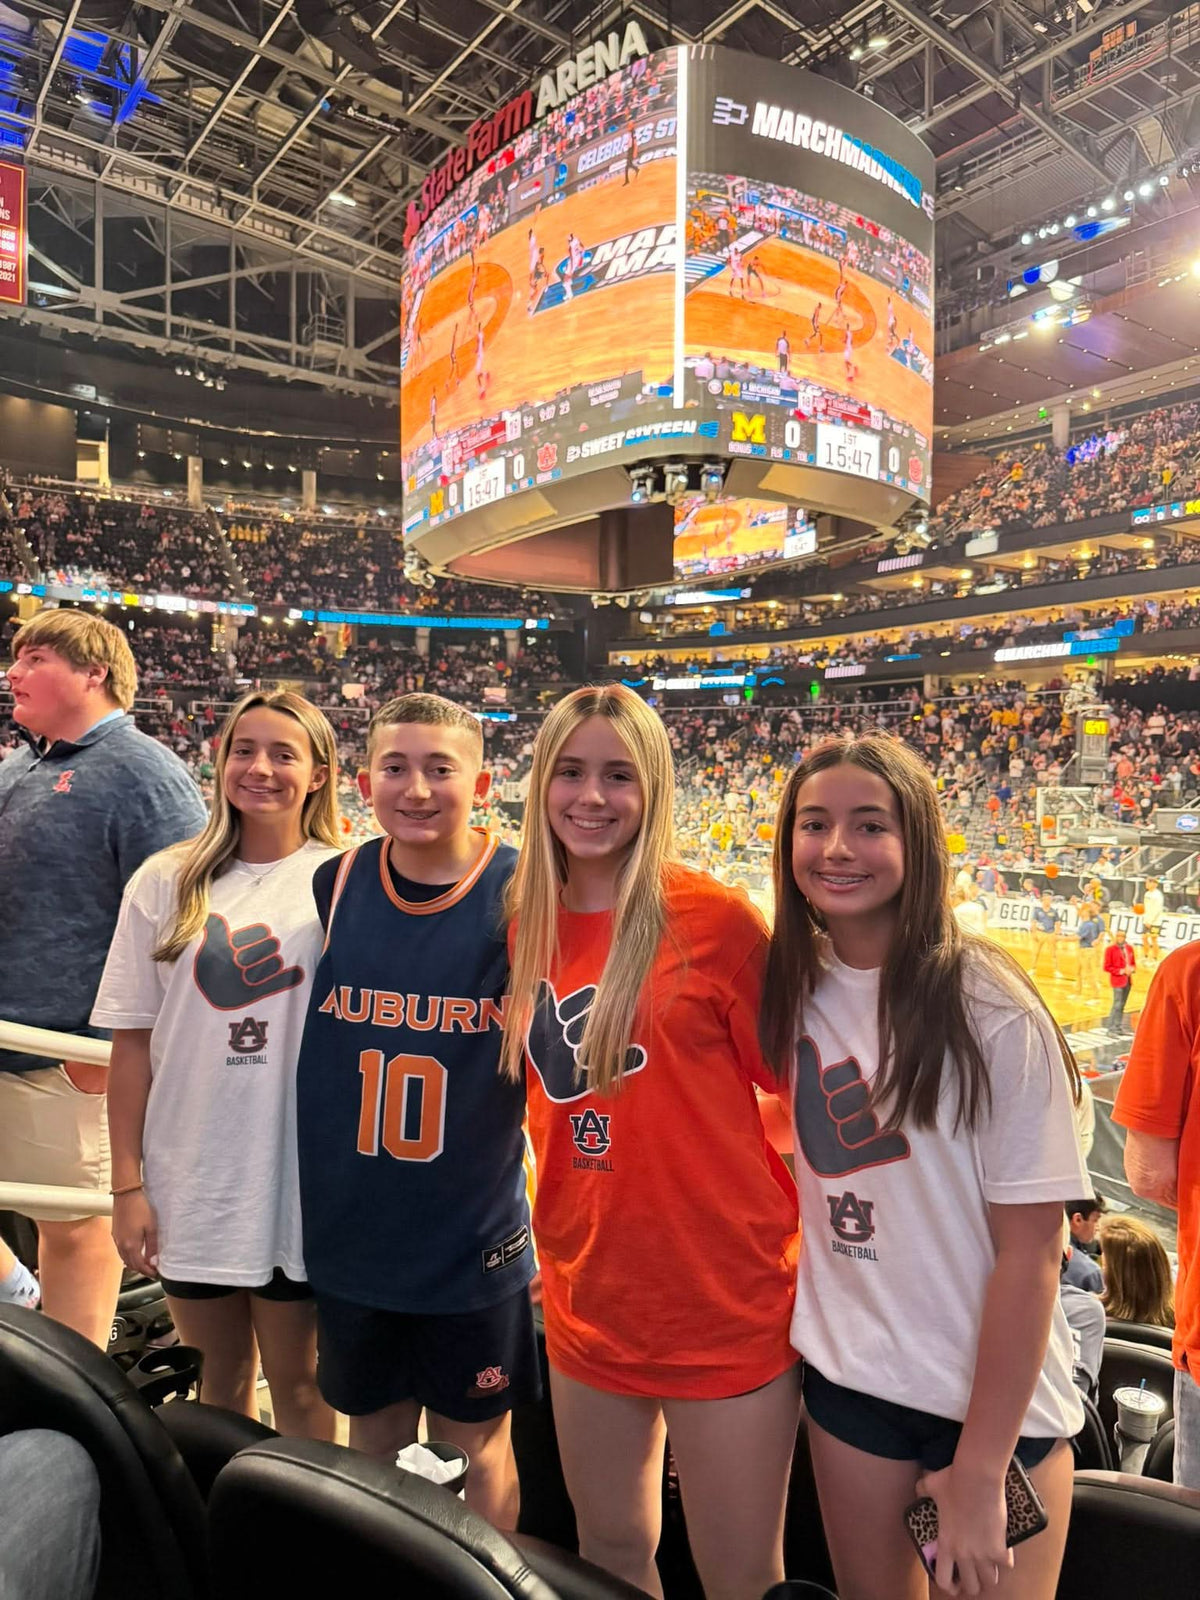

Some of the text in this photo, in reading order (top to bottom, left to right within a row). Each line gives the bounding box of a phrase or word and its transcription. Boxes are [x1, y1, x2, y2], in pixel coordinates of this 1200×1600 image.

[420, 20, 649, 222] State Farm ARENA
[752, 102, 844, 161] MARCH
[731, 411, 767, 443] M
[785, 420, 801, 449] 0
[580, 431, 626, 459] SWEET
[825, 442, 873, 476] 15:47
[513, 453, 524, 480] 0
[888, 446, 900, 474] 0
[448, 482, 458, 507] 0
[467, 476, 499, 506] 15:47
[318, 984, 514, 1033] AUBURN
[226, 1055, 268, 1066] BASKETBALL
[357, 1048, 448, 1162] 10
[572, 1157, 615, 1172] BASKETBALL
[831, 1240, 879, 1261] BASKETBALL
